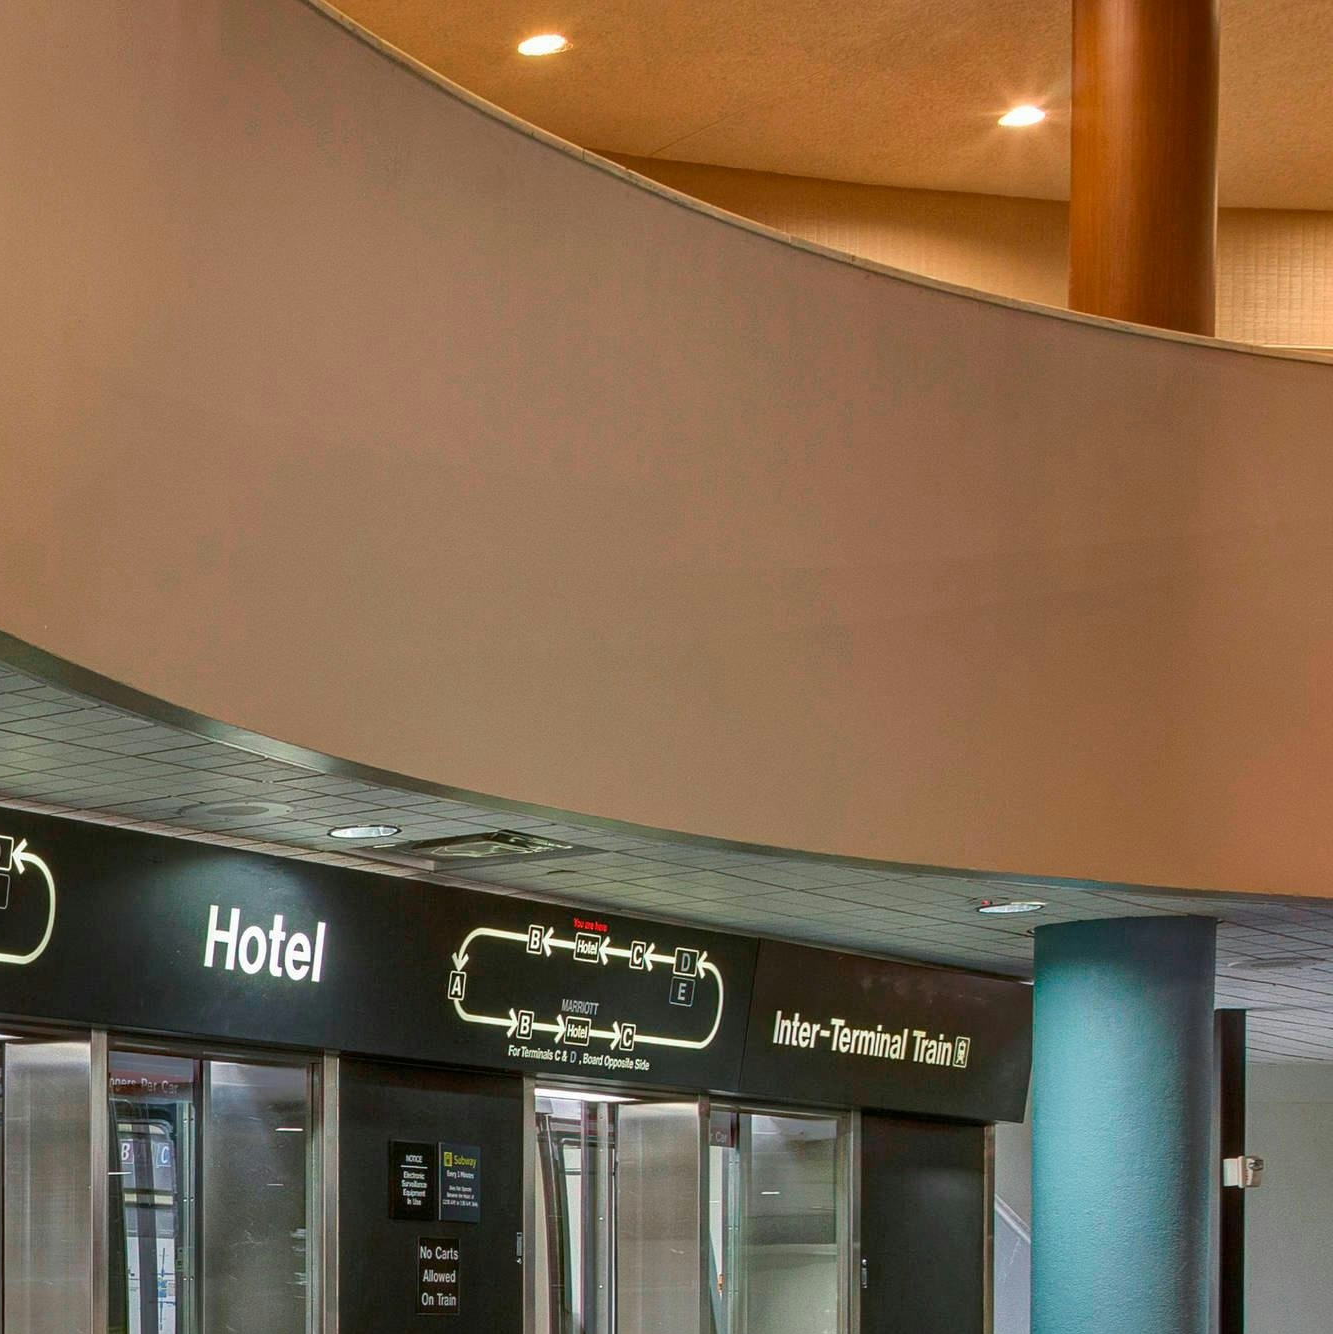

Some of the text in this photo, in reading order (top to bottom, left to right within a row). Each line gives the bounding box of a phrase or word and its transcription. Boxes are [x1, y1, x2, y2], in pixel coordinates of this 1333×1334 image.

[573, 918, 582, 929] You
[594, 922, 608, 932] here
[203, 904, 326, 982] Hotel
[530, 929, 541, 949] B
[577, 939, 598, 954] Hotel
[633, 945, 643, 965] C
[681, 953, 690, 972] D
[451, 975, 461, 996] A
[678, 983, 687, 1001] E
[561, 998, 600, 1016] MARRIOTT
[520, 1015, 531, 1034] B
[566, 1025, 588, 1039] Hotel
[623, 1030, 632, 1049] C
[773, 1010, 952, 1067] Inter-Terminal Train
[508, 1044, 520, 1057] For
[521, 1046, 553, 1060] Terminals
[555, 1050, 561, 1061] C
[561, 1050, 567, 1062] &
[604, 1056, 633, 1069] Opposite
[635, 1059, 650, 1071] Side
[121, 1142, 131, 1161] B
[160, 1145, 170, 1164] C
[420, 1246, 458, 1260] No Carts
[423, 1269, 456, 1283] Allowed
[421, 1292, 457, 1306] On Train
